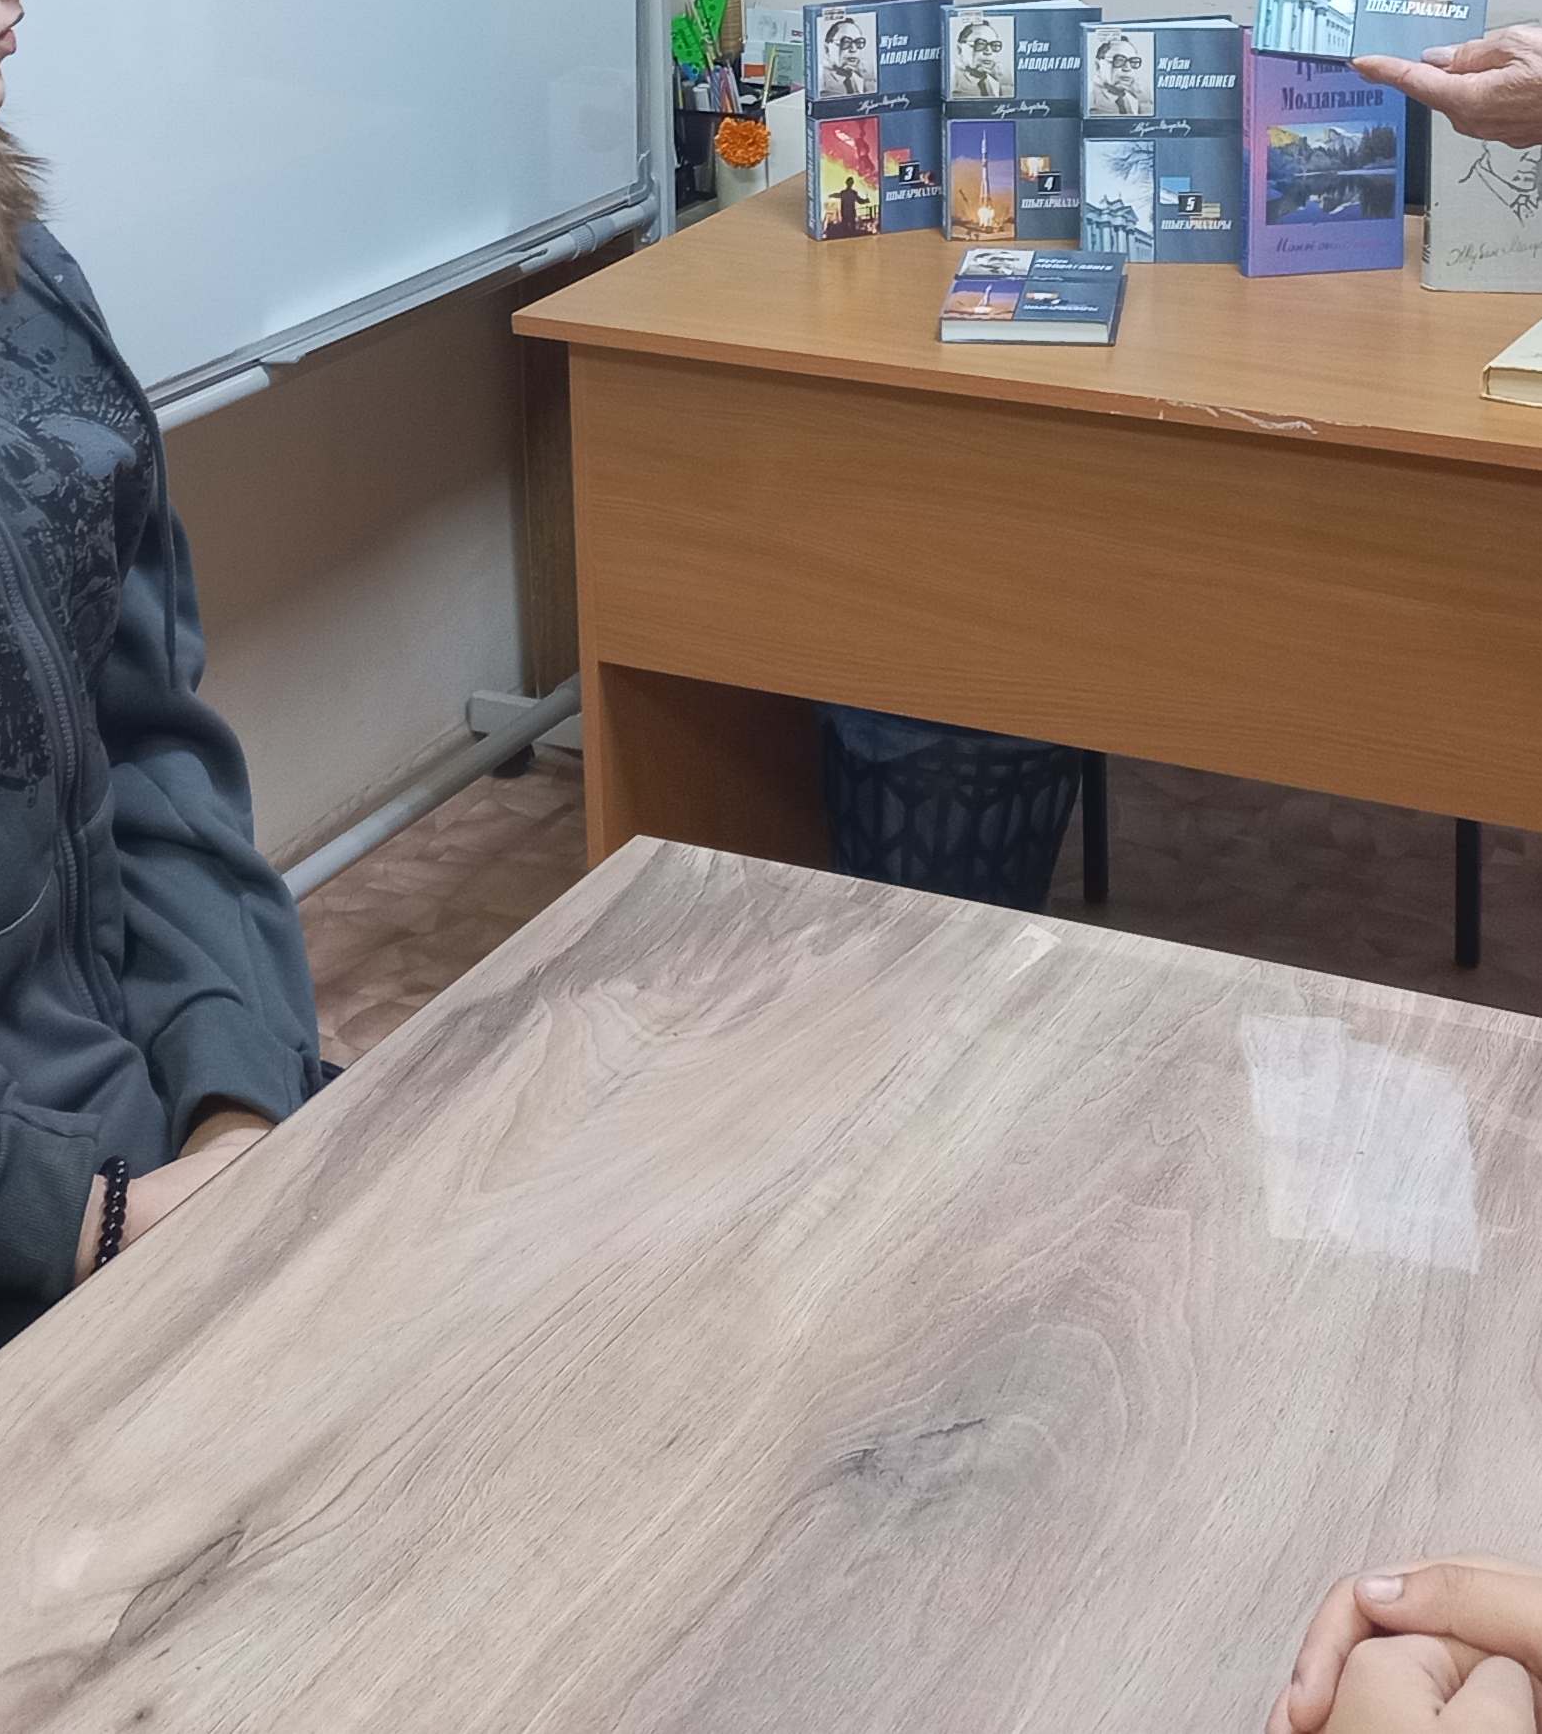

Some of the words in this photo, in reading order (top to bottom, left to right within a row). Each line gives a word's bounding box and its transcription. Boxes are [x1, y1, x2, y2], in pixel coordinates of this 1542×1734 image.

[904, 166, 914, 181] 3
[1044, 176, 1055, 191] 4
[1185, 196, 1197, 211] 5
